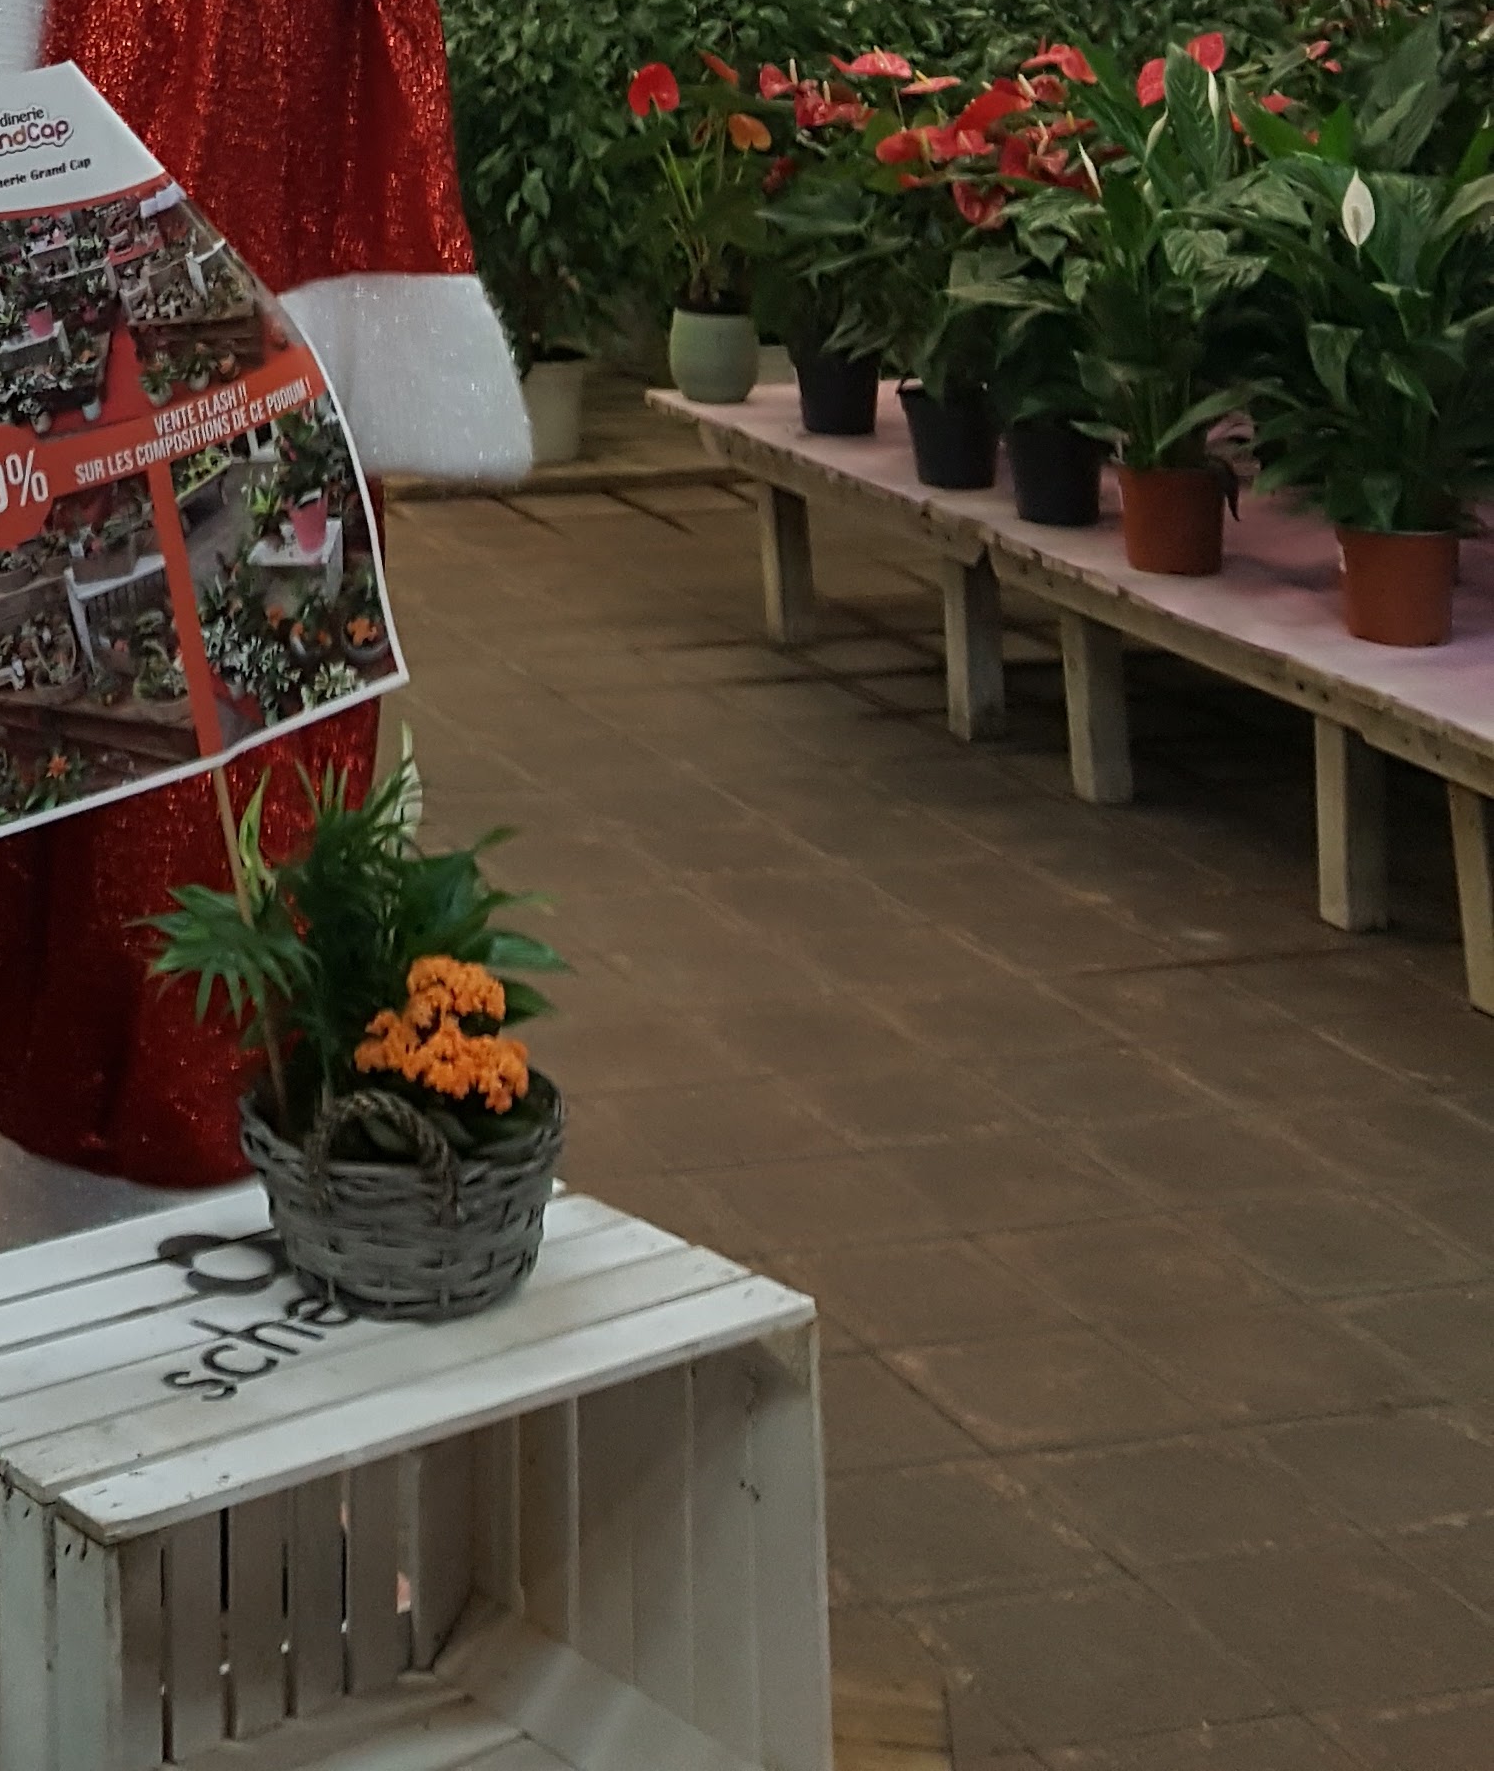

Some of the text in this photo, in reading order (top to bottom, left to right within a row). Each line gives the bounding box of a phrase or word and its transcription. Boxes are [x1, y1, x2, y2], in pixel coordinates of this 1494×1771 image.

[30, 163, 67, 182] Grand
[69, 158, 92, 171] Cap
[74, 458, 106, 485] SUR
[106, 451, 134, 475] LES
[135, 415, 231, 468] COMPOSITIONS
[231, 407, 248, 431] DE
[248, 399, 265, 423] CE
[266, 377, 307, 416] PODIUM
[154, 407, 197, 436] VENTE
[197, 389, 237, 418] FLASH
